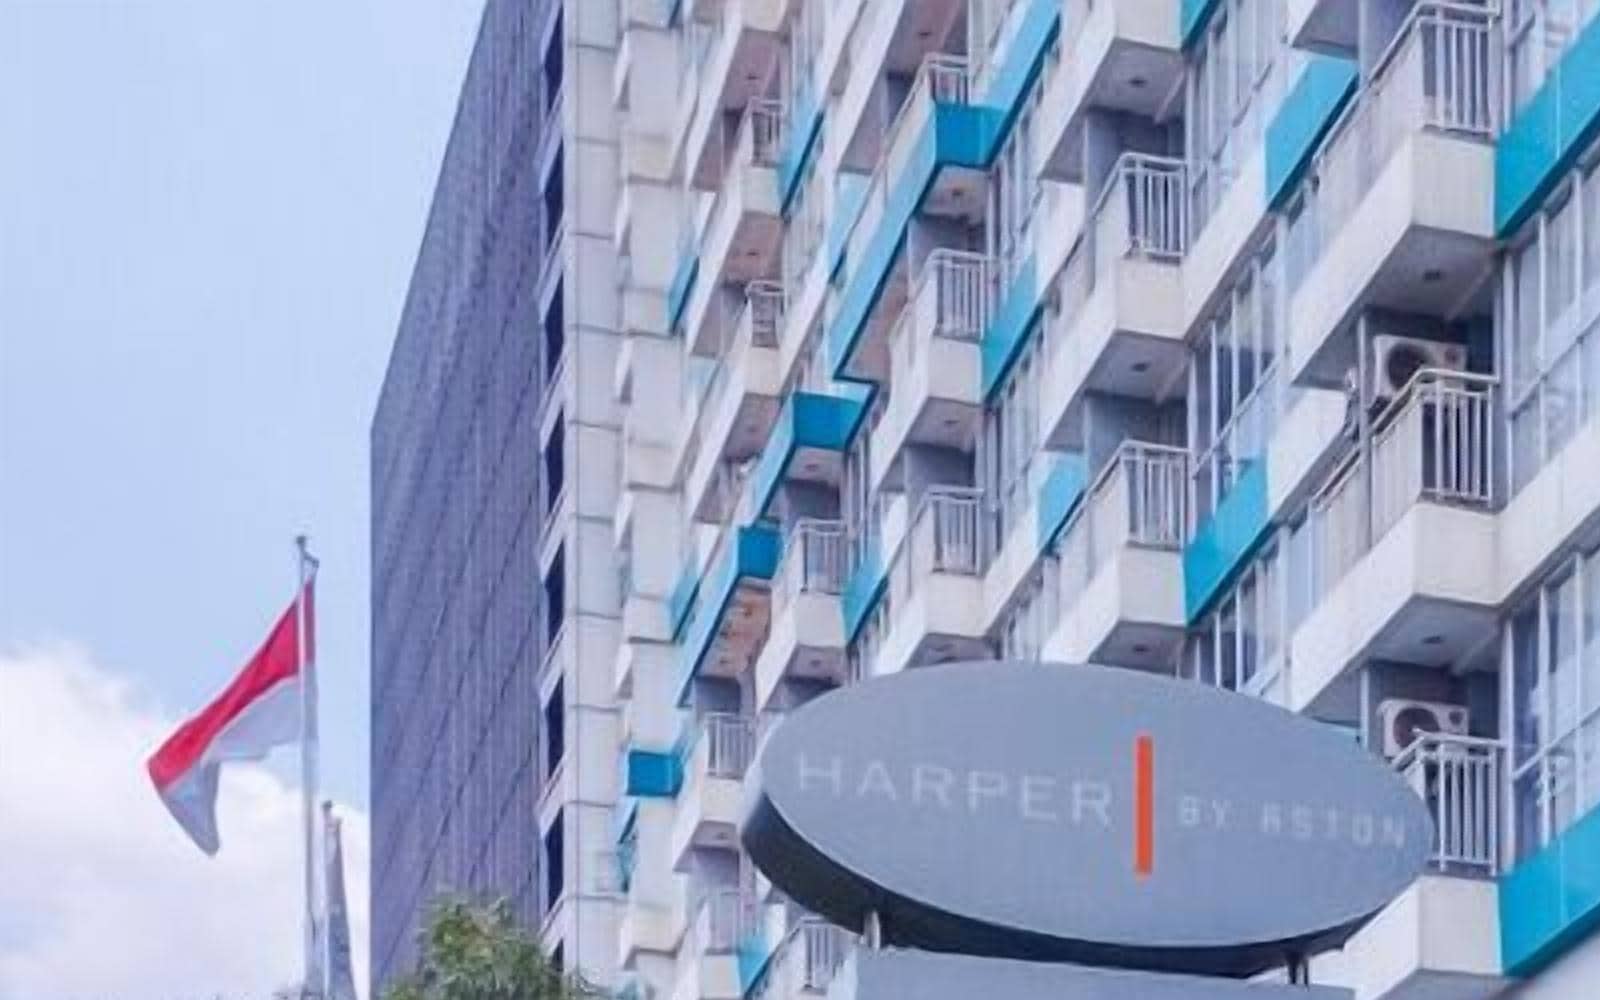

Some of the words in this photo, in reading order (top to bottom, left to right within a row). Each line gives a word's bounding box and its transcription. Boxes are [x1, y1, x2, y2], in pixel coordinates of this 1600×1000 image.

[798, 752, 1114, 828] HARPER
[1180, 796, 1232, 829] BY
[1261, 803, 1406, 849] ASTON
